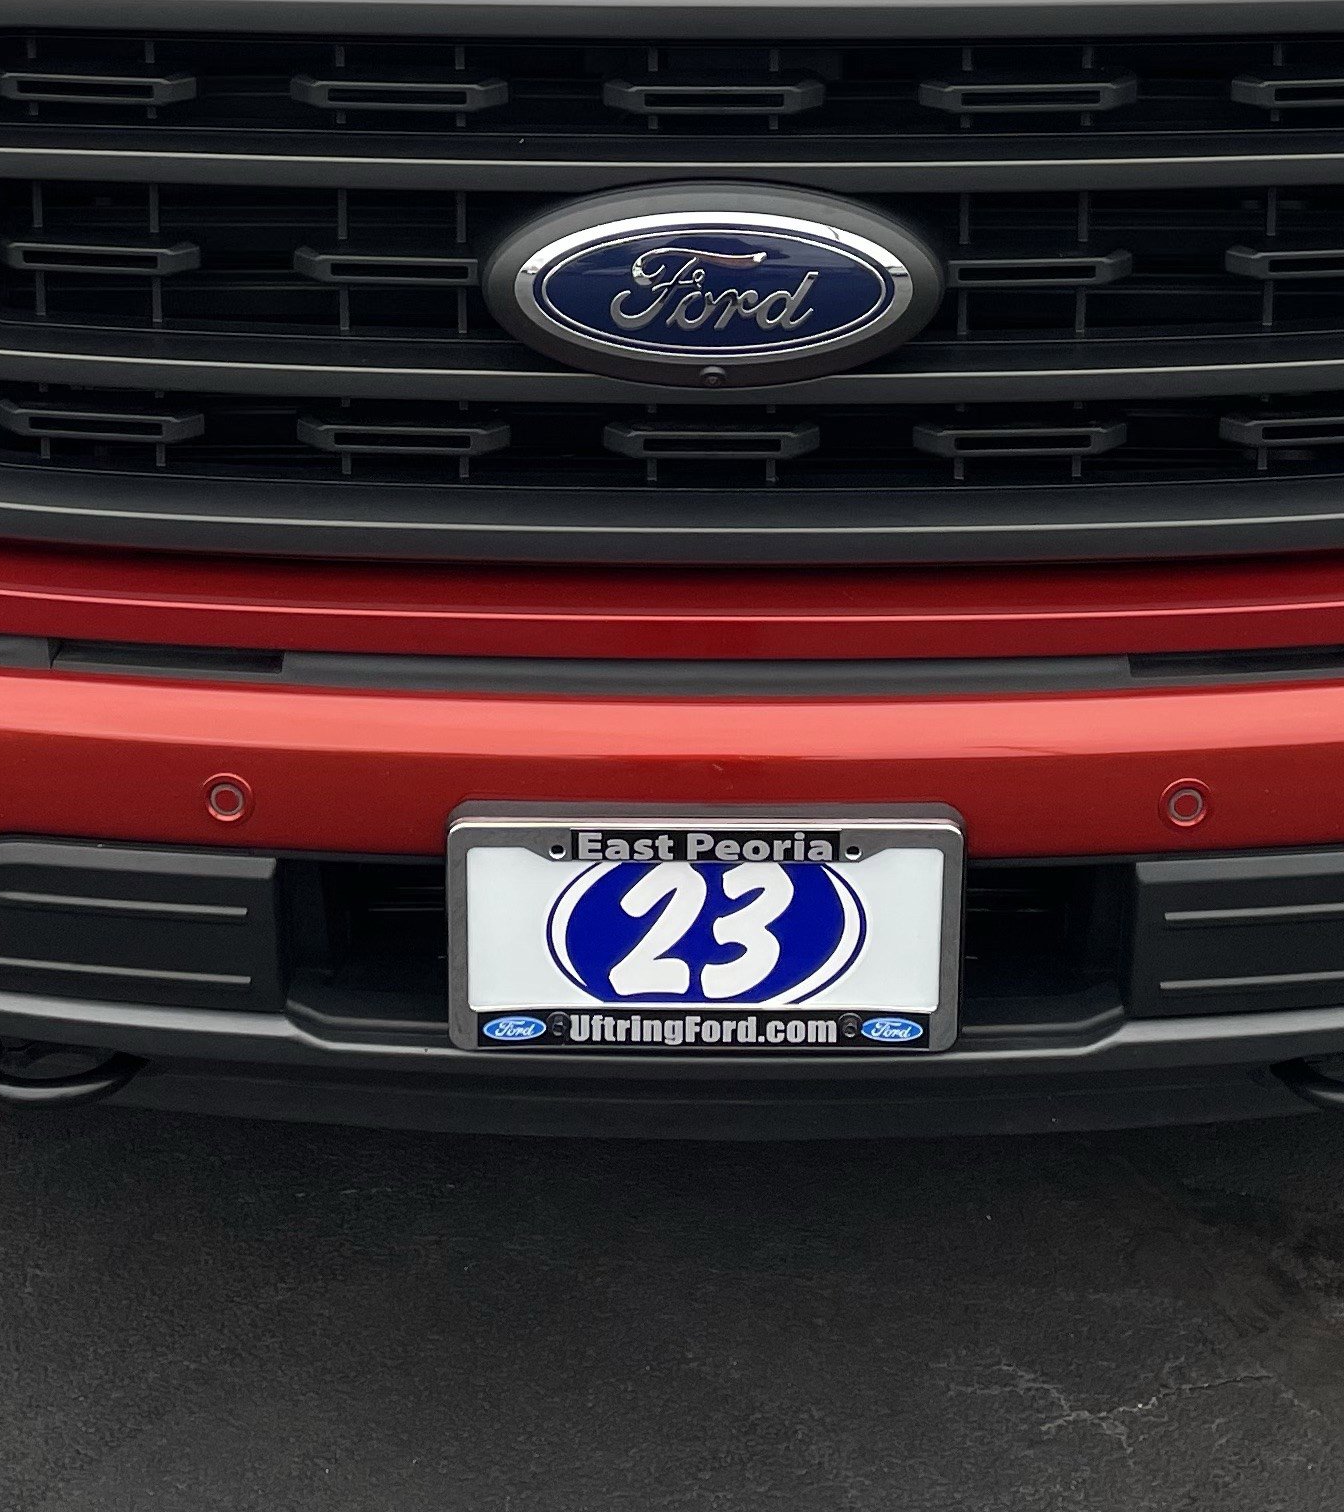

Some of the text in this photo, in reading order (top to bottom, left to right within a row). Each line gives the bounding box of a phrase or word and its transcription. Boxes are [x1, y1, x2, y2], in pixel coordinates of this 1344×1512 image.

[610, 247, 819, 332] Ford
[578, 831, 833, 861] East Peoria
[608, 862, 794, 999] 23
[495, 1020, 535, 1037] Ford
[569, 1015, 837, 1045] UftringFord.com
[871, 1021, 912, 1038] Ford
